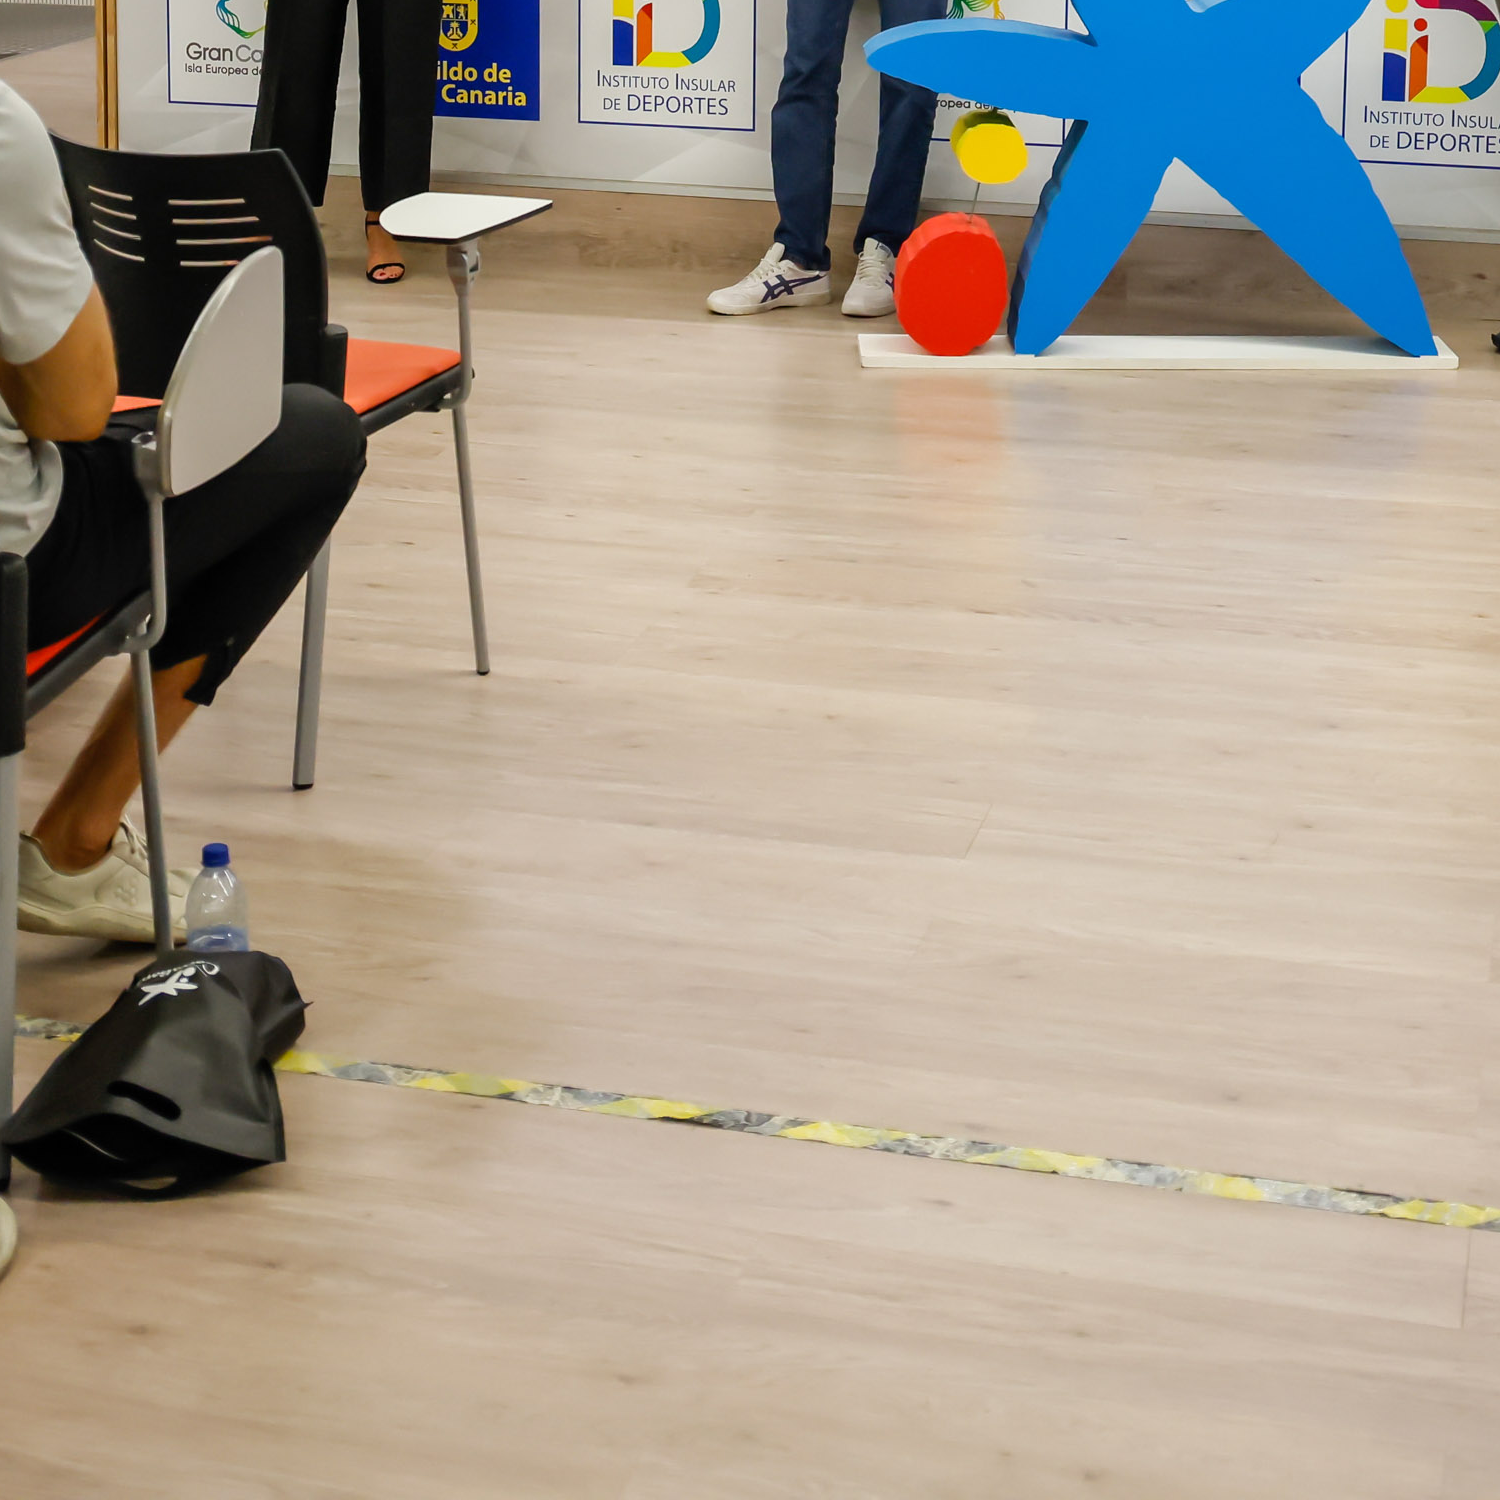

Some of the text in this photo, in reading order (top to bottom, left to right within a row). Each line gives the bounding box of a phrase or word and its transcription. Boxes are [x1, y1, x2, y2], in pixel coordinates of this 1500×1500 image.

[186, 42, 233, 62] Gran
[185, 63, 202, 73] Isla
[205, 64, 249, 76] Europea
[436, 60, 512, 83] ildo de
[441, 83, 527, 106] Canaria
[603, 94, 729, 116] DE DEPORTES
[1369, 135, 1390, 149] DE
